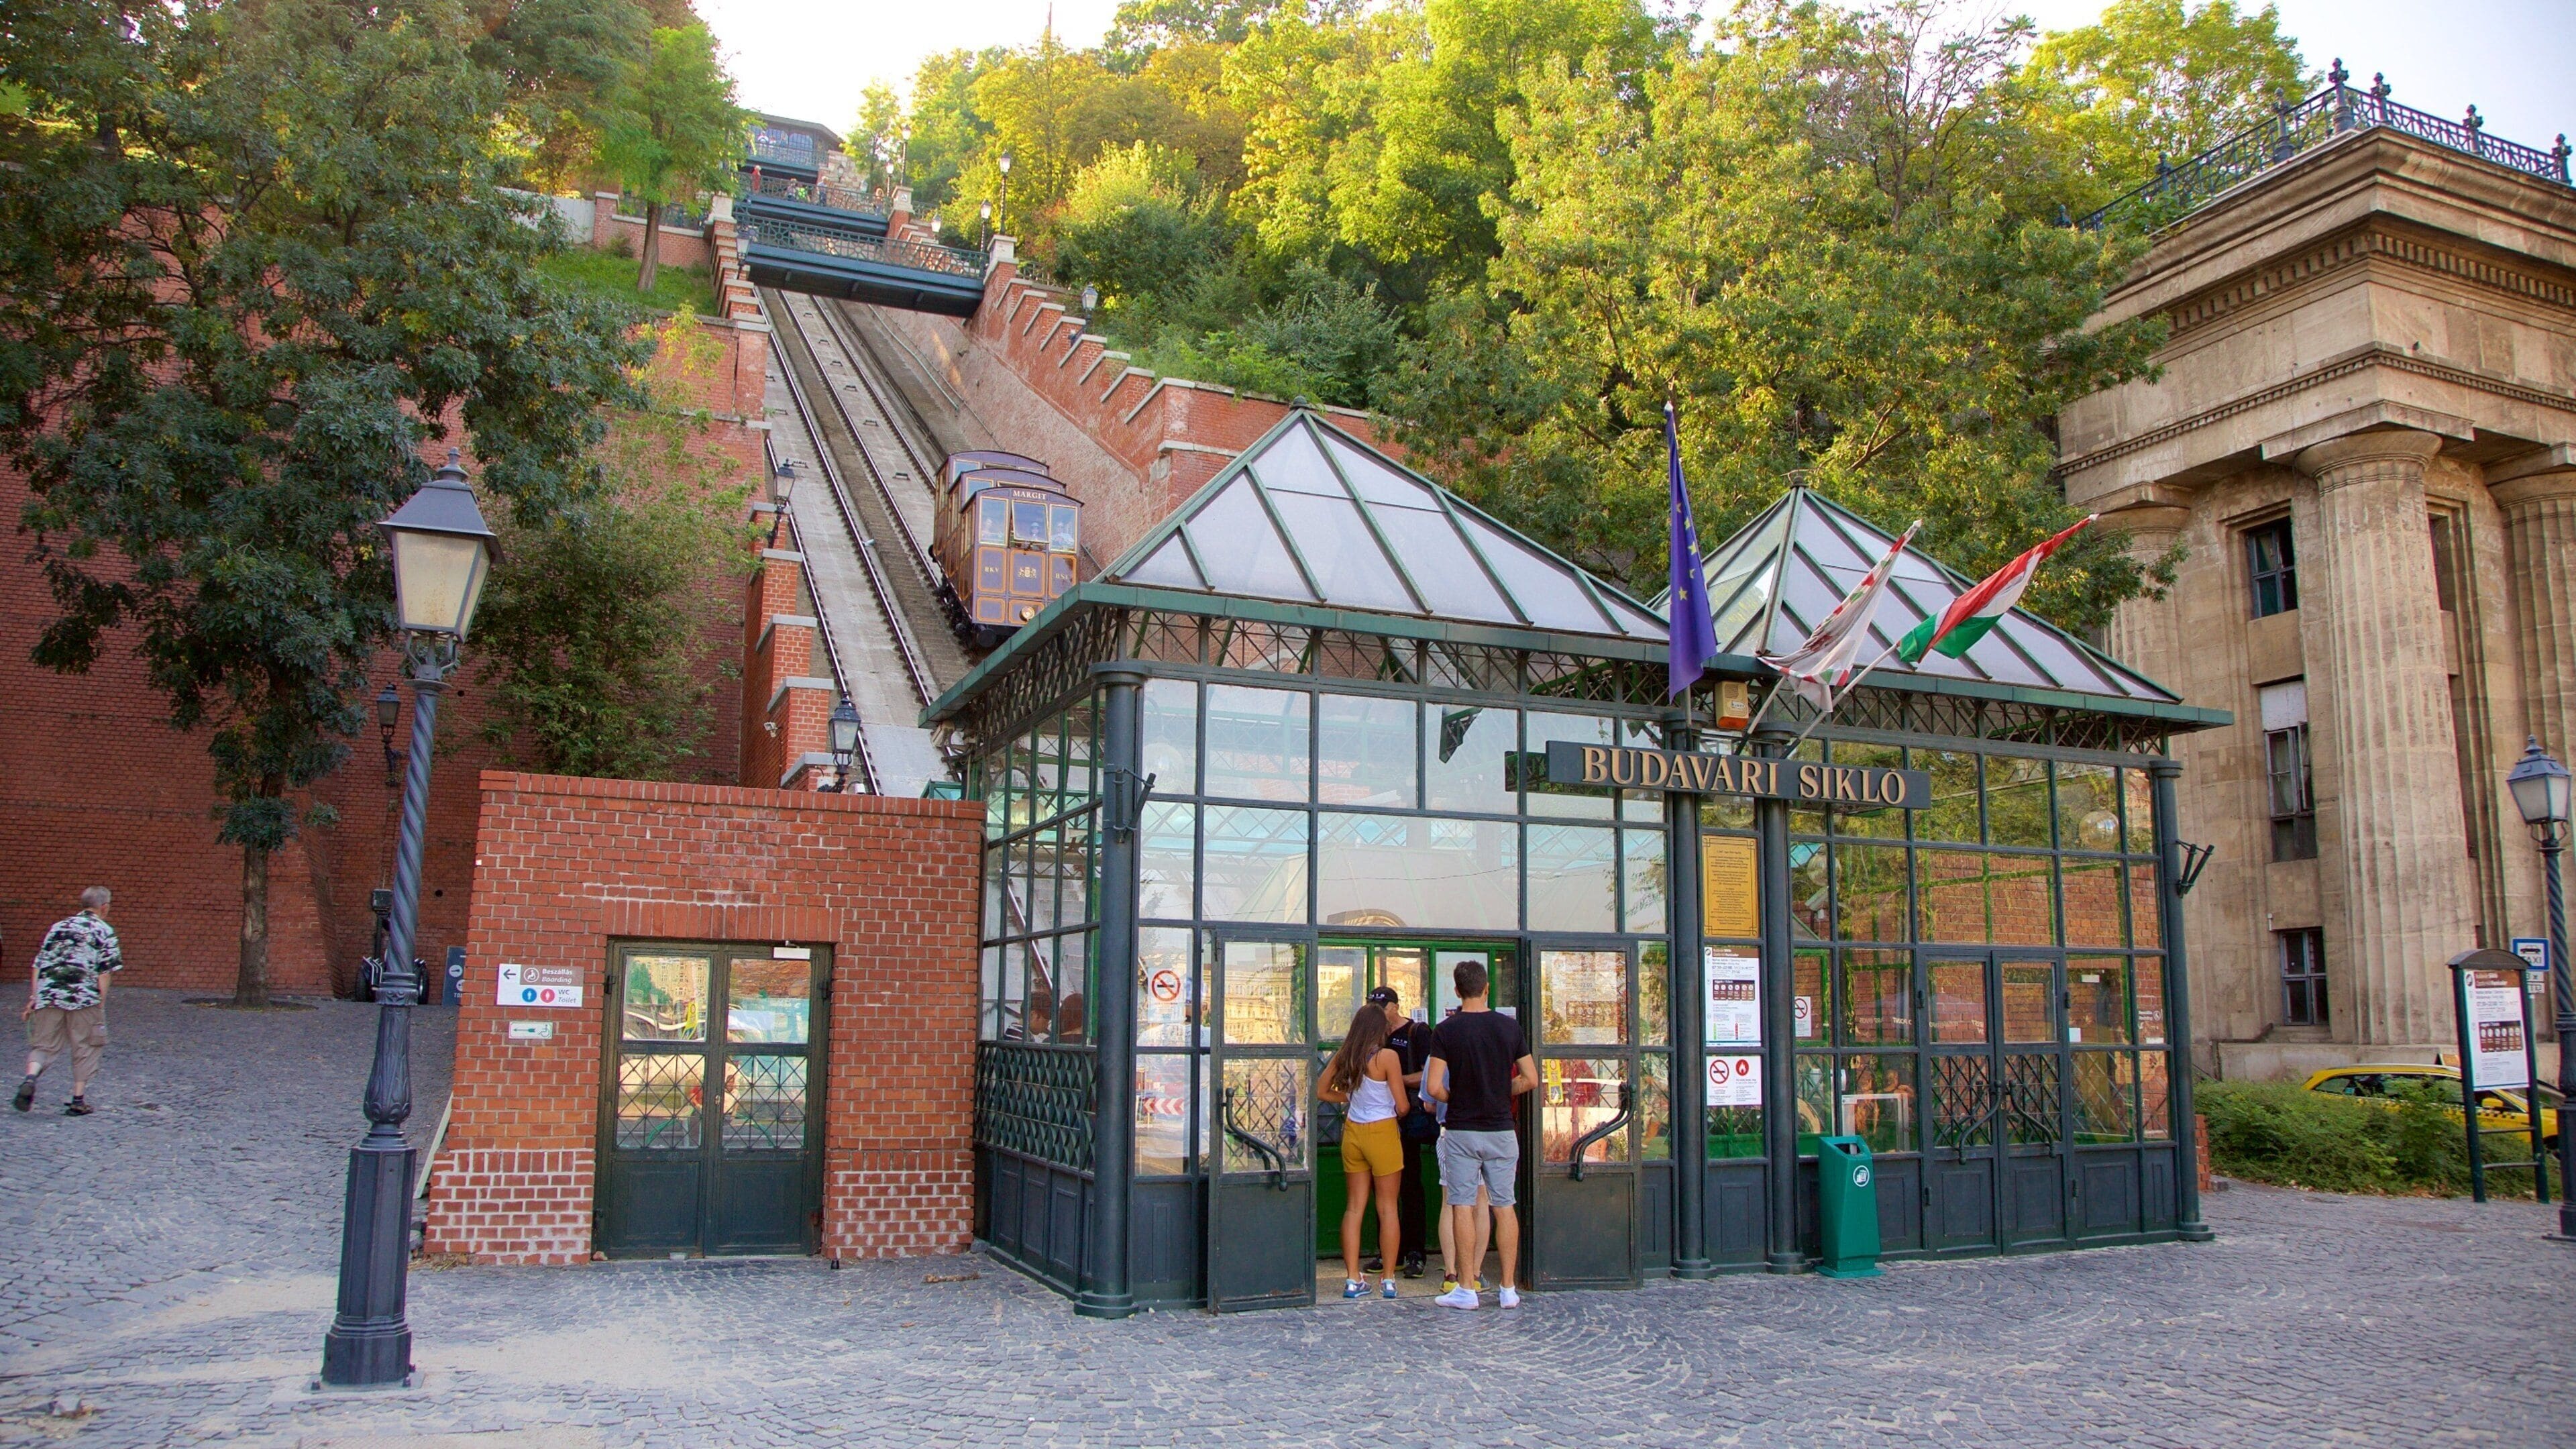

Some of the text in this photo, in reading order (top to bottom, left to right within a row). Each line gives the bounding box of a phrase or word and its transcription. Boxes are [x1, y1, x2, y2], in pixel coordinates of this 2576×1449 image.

[1012, 490, 1047, 500] MARGIT
[1581, 746, 1907, 805] BUDAVÁRI SIKLÓ
[541, 976, 572, 984] Boarding
